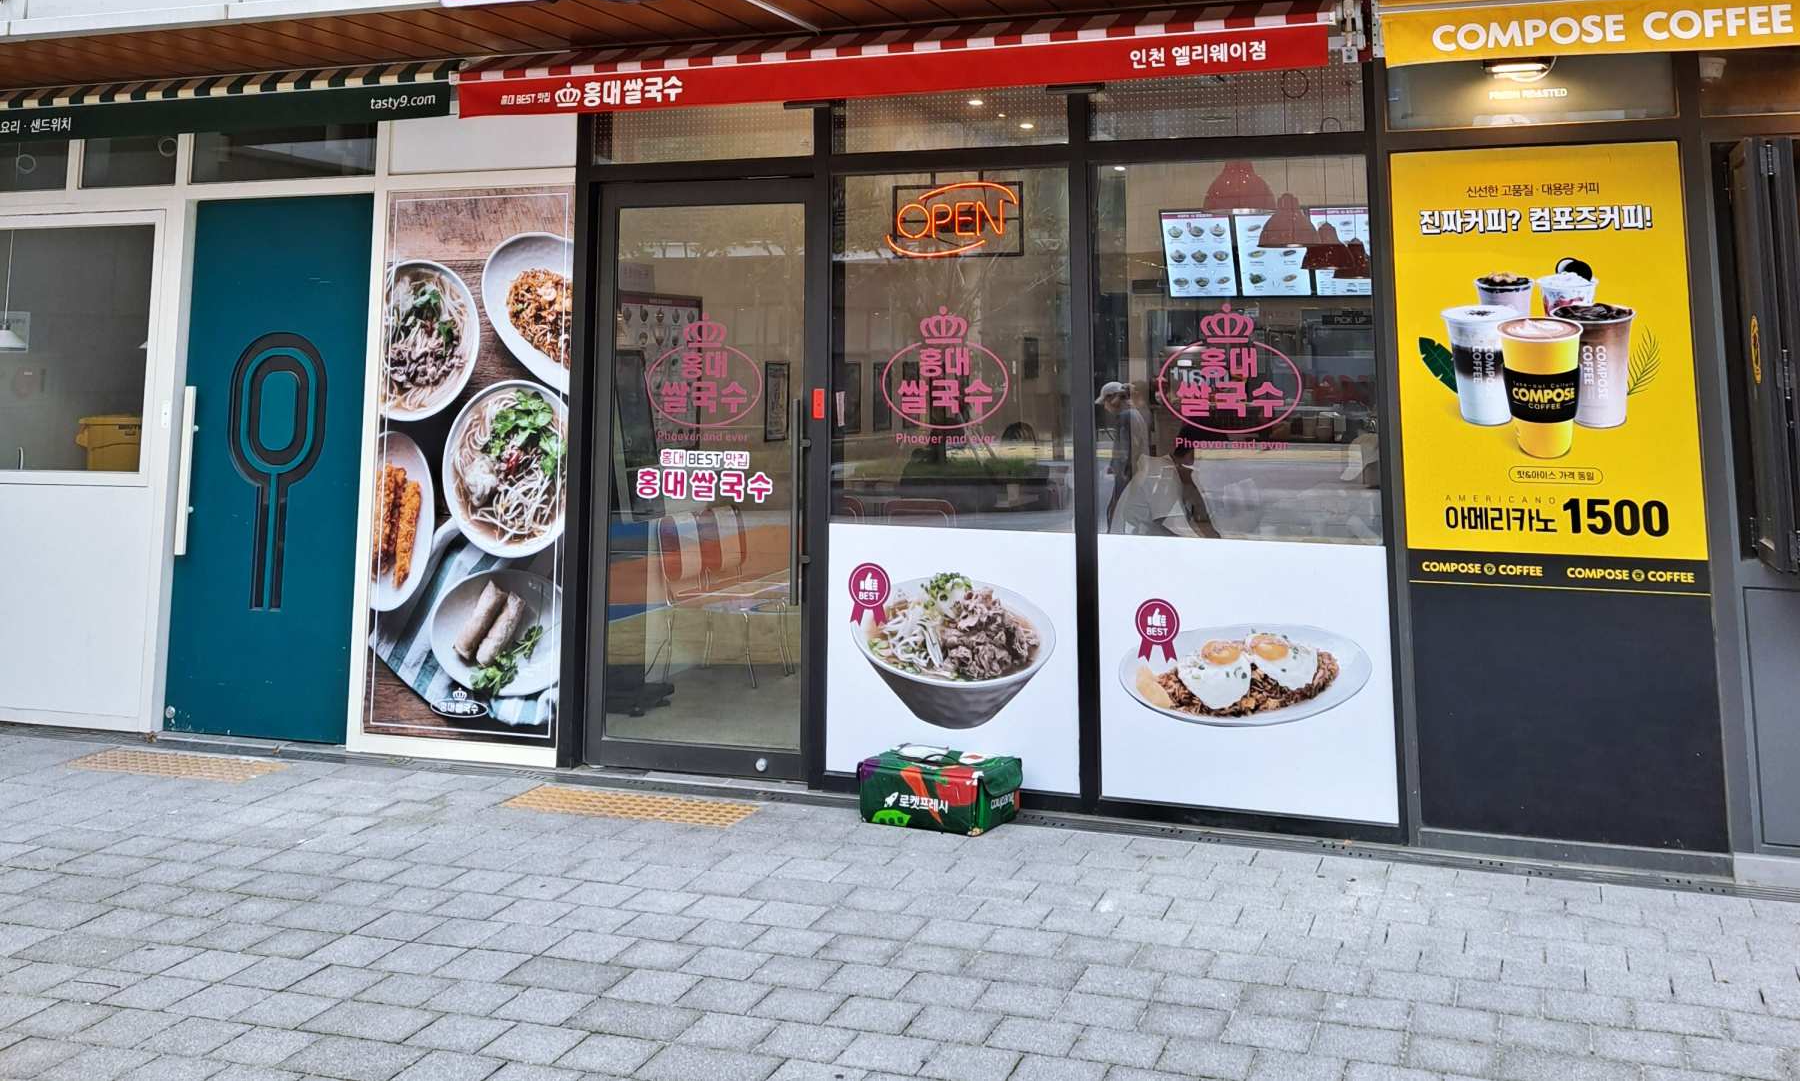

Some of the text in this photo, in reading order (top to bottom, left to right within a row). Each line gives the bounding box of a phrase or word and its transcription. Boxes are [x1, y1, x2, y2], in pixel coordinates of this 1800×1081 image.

[1431, 4, 1794, 52] COMPOSE COFFEE
[1129, 40, 1267, 69] 인천 엘리웨이점
[516, 93, 535, 105] BEST
[583, 75, 683, 107] 홍대쌀국수
[370, 93, 436, 110] tasty9.com
[0, 117, 71, 134] 요리 샌드위치
[1466, 181, 1600, 198] 신선한 고품질 대용량 커피
[896, 199, 1005, 239] OPEN
[1419, 204, 1653, 235] 진짜커피? 컴포즈커피!
[682, 350, 728, 379] 홍대
[919, 346, 970, 377] 홍대
[1200, 347, 1258, 378] 홍대
[1582, 345, 1594, 385] COFFEE
[661, 380, 748, 413] 쌀국수
[897, 379, 993, 414] 쌀국수
[1177, 381, 1285, 418] 쌀국수
[1512, 386, 1575, 404] COMPOSE
[1528, 402, 1561, 411] COFFEE
[896, 433, 995, 446] Phoever and ever
[1232, 438, 1256, 450] and
[662, 450, 748, 467] 홍대 BEST 맛집
[637, 469, 772, 502] 홍대쌀국수
[1559, 470, 1575, 480] 가격
[1578, 471, 1594, 481] 동일
[1445, 494, 1556, 505] AMERICANO
[1445, 497, 1669, 538] 아메리카노 1500
[1421, 561, 1543, 577] COMPOSE COFFEE
[1566, 567, 1695, 583] COMPOSE COFFEE
[858, 591, 880, 600] BEST
[1146, 627, 1168, 636] BEST
[899, 794, 949, 814] 로켓프레시
